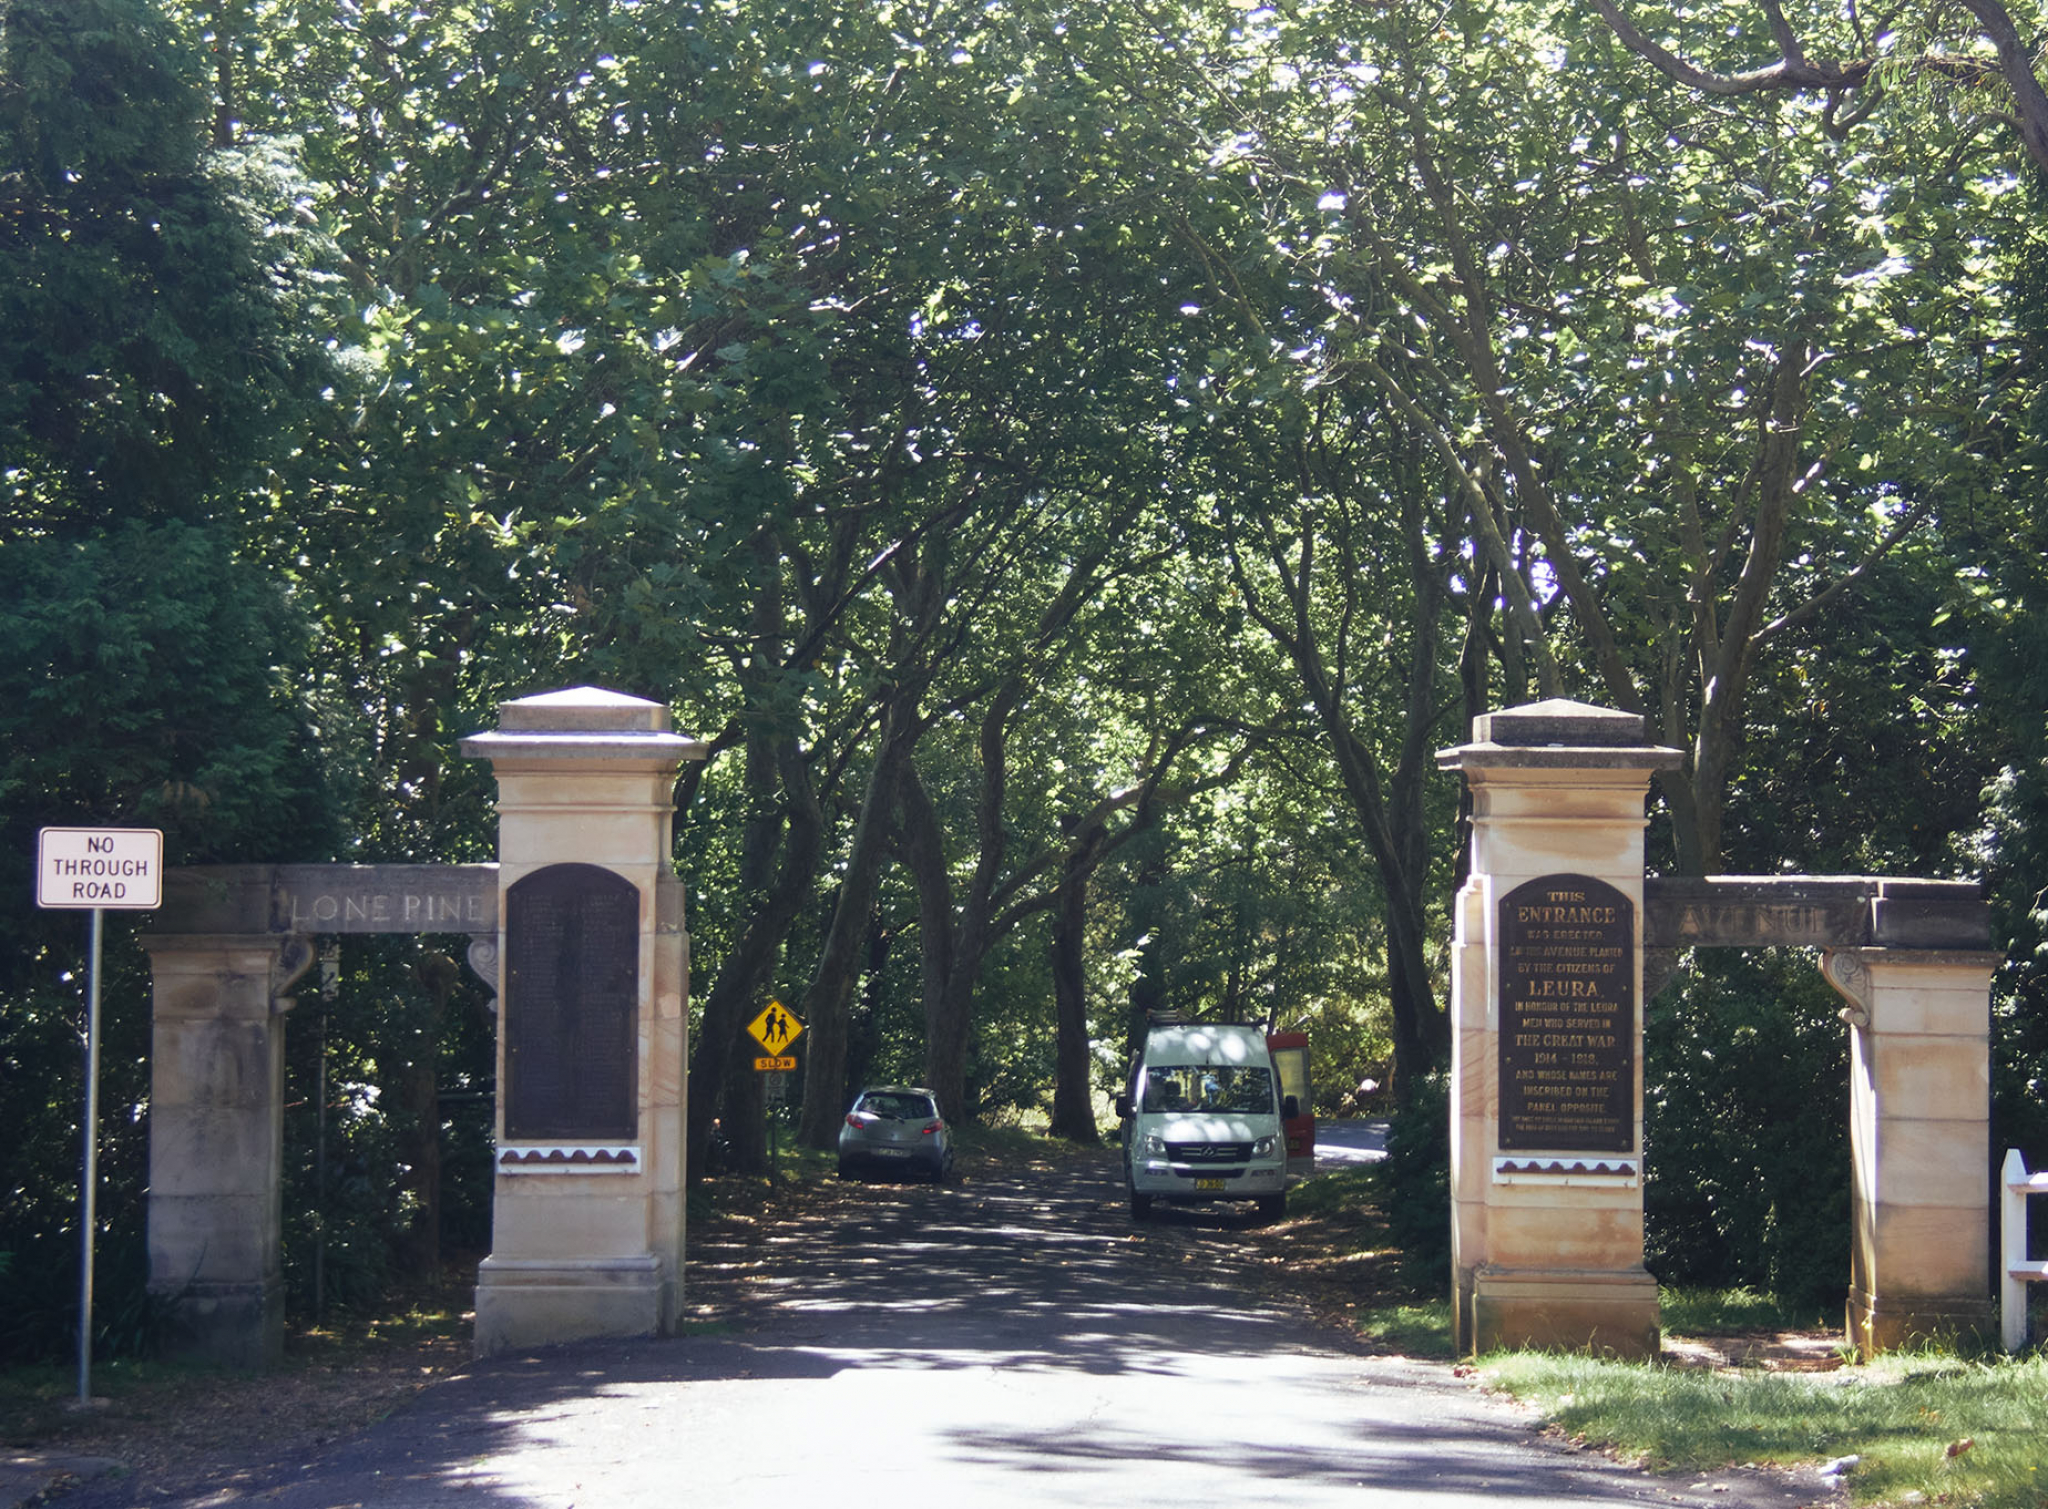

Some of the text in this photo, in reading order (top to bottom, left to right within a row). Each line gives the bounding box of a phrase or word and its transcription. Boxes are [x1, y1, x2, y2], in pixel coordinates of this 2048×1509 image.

[87, 836, 114, 853] NO
[54, 859, 147, 876] THROUGH
[73, 882, 125, 899] ROAD
[1547, 891, 1586, 902] THIS
[293, 895, 483, 921] LONE PINE
[1517, 906, 1615, 924] ENTRANCE
[1543, 947, 1587, 957] AVENUE
[1517, 963, 1615, 974] BY THE CITIZENS OF
[1560, 1002, 1570, 1011] OF
[1573, 1002, 1587, 1012] THE
[1590, 1002, 1618, 1012] LEURA
[1522, 1018, 1611, 1029] MEN WHO SERVED IN
[1515, 1034, 1540, 1046] THE
[1543, 1034, 1584, 1046] GREAT
[760, 1059, 792, 1068] SLOW
[1534, 1052, 1557, 1064] 1914
[1515, 1070, 1618, 1081] AND WHOSE NAMES ARE
[1523, 1085, 1609, 1097] INSCRIBED ON THE
[1527, 1102, 1556, 1112] PANEL
